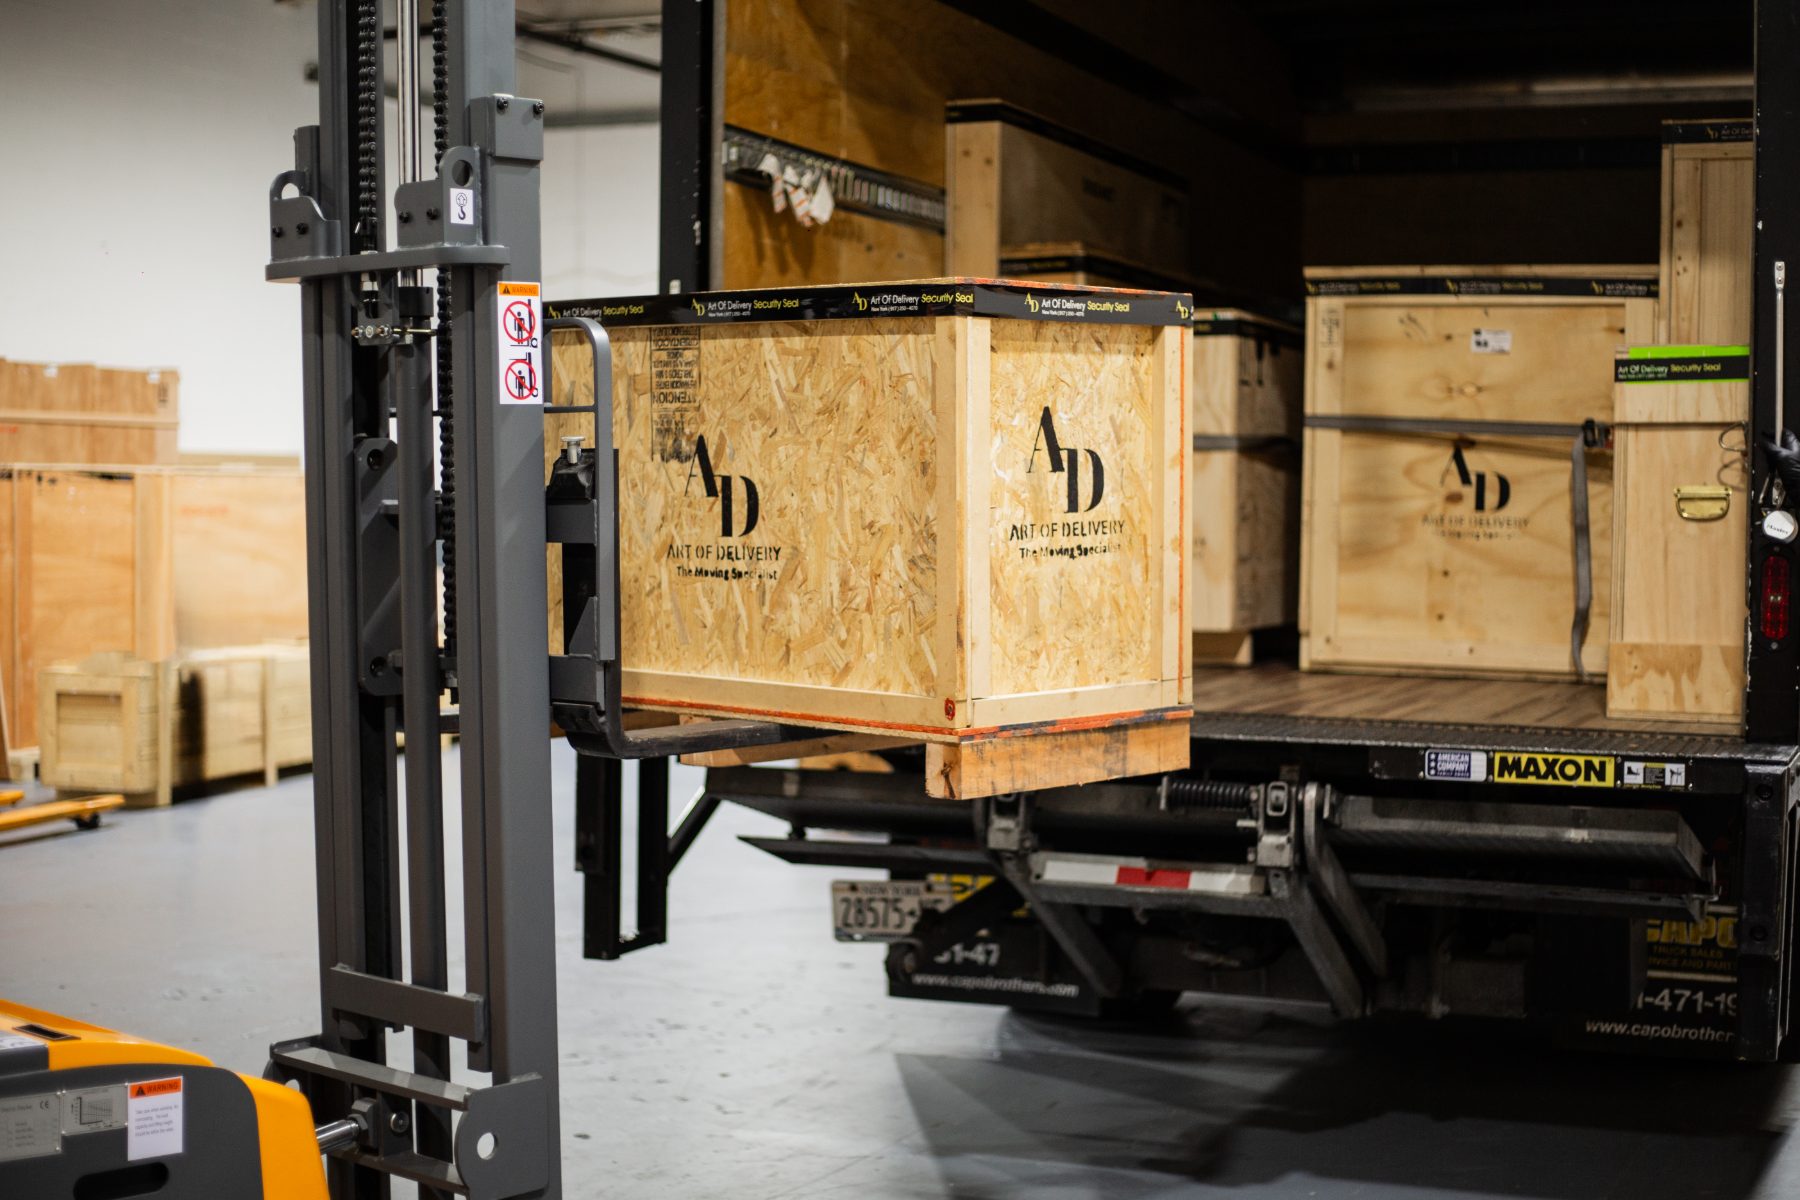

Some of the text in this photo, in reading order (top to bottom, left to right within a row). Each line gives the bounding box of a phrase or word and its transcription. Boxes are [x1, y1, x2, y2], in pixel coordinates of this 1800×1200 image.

[707, 302, 717, 311] Art
[718, 300, 727, 311] Of
[728, 300, 752, 312] Delivery
[753, 299, 781, 309] Security
[783, 298, 799, 308] Seal
[870, 295, 881, 305] Art
[882, 294, 892, 304] Of
[893, 294, 919, 305] Delivery
[921, 293, 953, 304] Security
[955, 292, 974, 303] Seal
[563, 309, 571, 317] Art
[572, 307, 580, 317] Of
[580, 306, 602, 317] Delivery
[603, 305, 628, 316] Security
[629, 304, 644, 314] Seal
[1041, 299, 1051, 308] Art
[1052, 299, 1062, 309] Of
[1062, 300, 1086, 312] Delivery
[1087, 301, 1114, 313] Security
[1115, 303, 1130, 313] Seal
[1618, 362, 1721, 374] Art Of Delivery Security Seal
[1026, 405, 1105, 514] AD
[684, 434, 760, 538] AD
[1009, 519, 1125, 541] ART OF DELIVERY
[666, 544, 782, 562] ART OF DELIVERY
[1019, 547, 1037, 559] The
[677, 566, 692, 577] The
[694, 566, 729, 581] Moving
[1497, 756, 1606, 783] MAXON
[147, 1082, 178, 1093] WARNING
